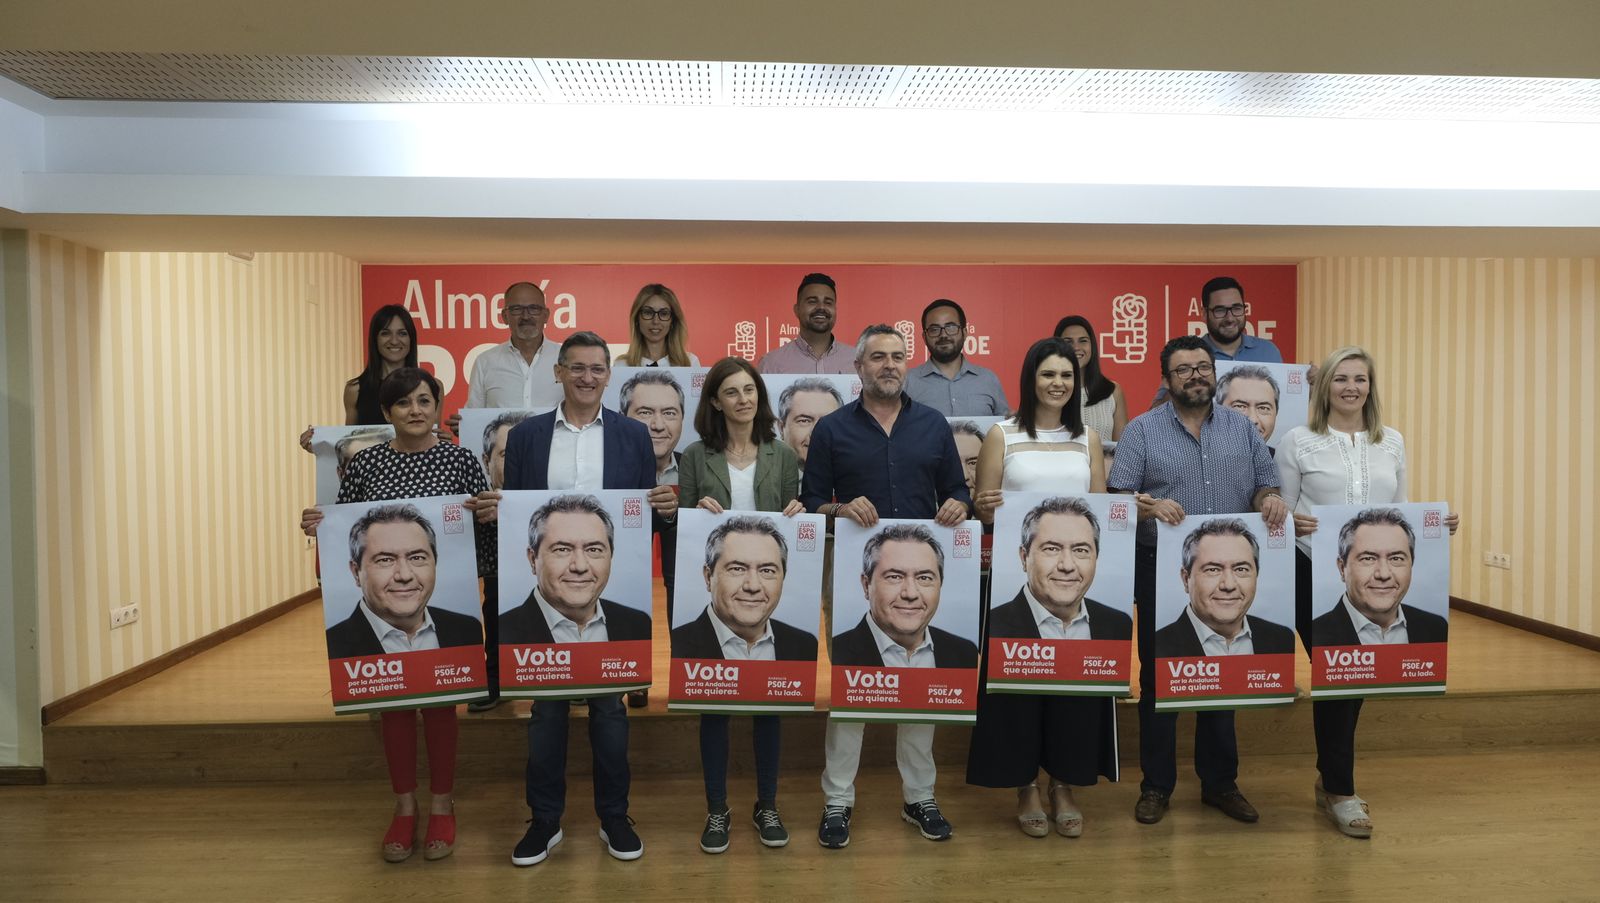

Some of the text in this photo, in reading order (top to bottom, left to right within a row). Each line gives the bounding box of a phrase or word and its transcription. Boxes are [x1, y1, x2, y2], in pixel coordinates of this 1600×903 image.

[513, 648, 571, 666] Vota
[1002, 642, 1055, 660] Vota
[1324, 650, 1375, 666] Vota
[344, 659, 403, 679] Vota
[684, 662, 739, 681] Vota
[1022, 667, 1056, 675] quieres.
[1168, 660, 1219, 677] Vota
[536, 673, 573, 681] quieres.
[845, 670, 899, 688] Vota
[1326, 673, 1376, 682] que quieres.
[349, 683, 407, 696] que quieres.
[704, 687, 739, 696] quieres.
[1188, 684, 1222, 692] quieres.
[847, 695, 900, 704] que quieres.
